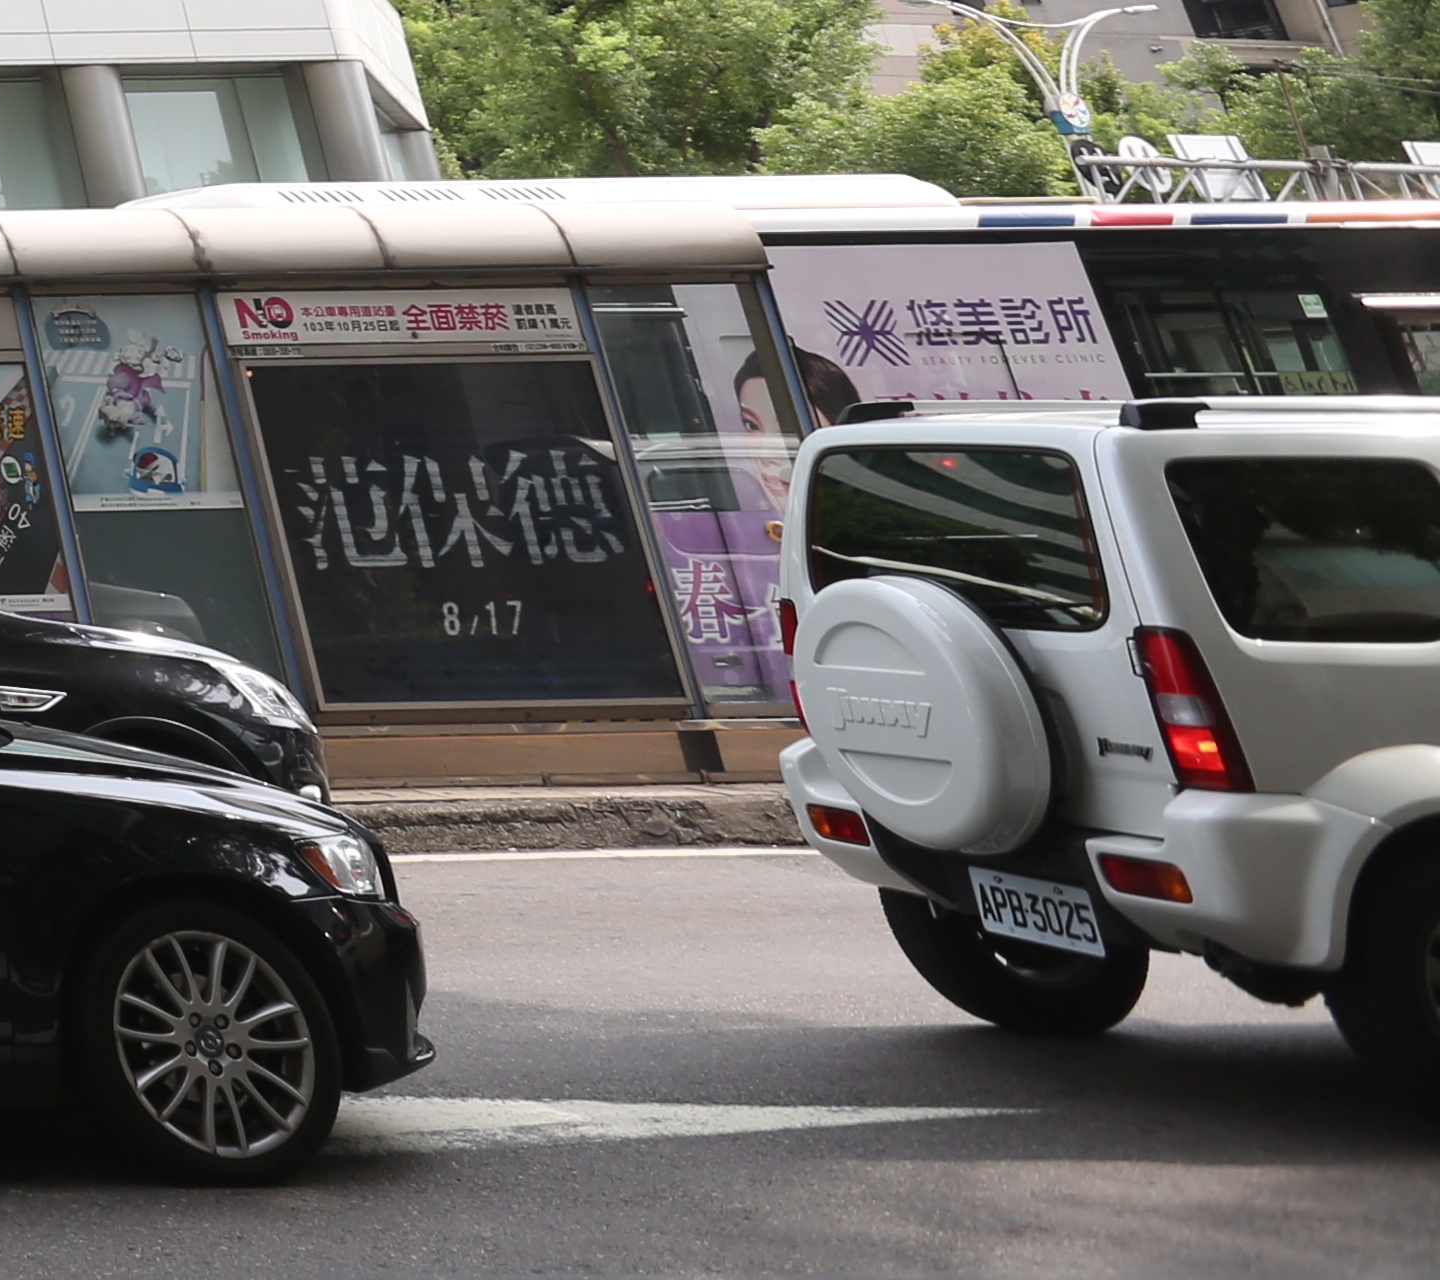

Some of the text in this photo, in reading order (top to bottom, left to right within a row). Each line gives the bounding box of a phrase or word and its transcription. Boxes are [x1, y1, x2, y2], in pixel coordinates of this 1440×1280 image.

[235, 297, 294, 329] NO
[302, 320, 401, 332] 103年10月25日起
[402, 302, 511, 331] 全面禁菸
[906, 297, 1100, 346] 悠美診所
[242, 330, 299, 342] Smoking
[921, 353, 1106, 367] BEAUTY FOREVER CLINIC
[980, 882, 1099, 944] APB-3025
